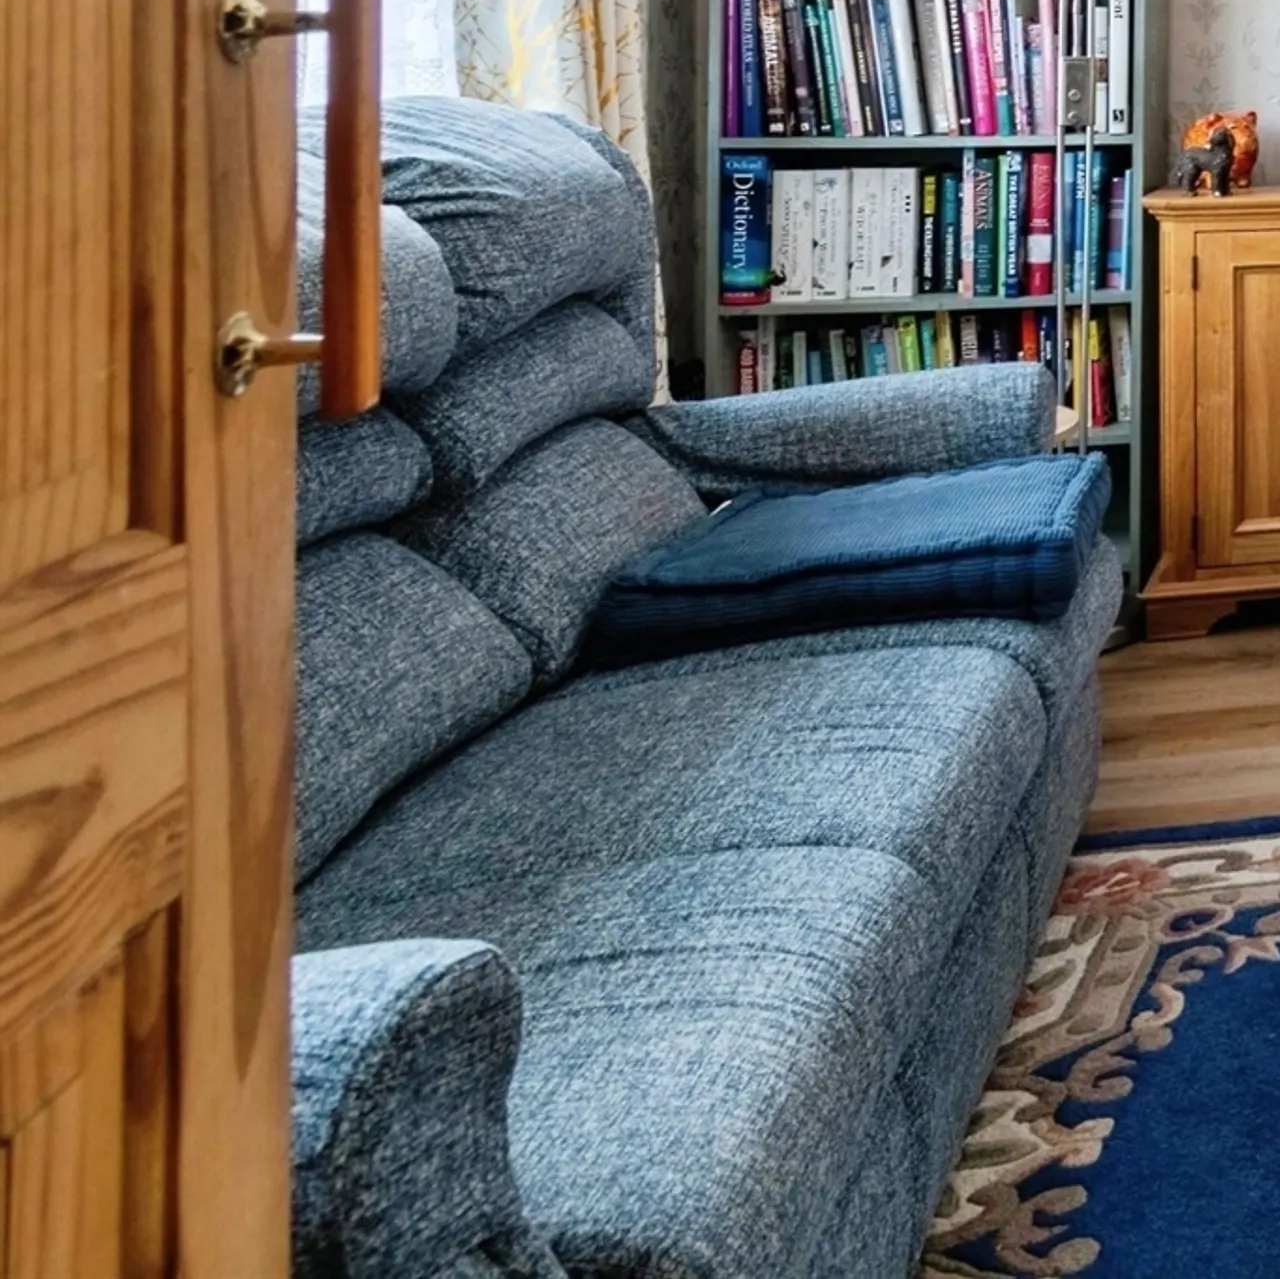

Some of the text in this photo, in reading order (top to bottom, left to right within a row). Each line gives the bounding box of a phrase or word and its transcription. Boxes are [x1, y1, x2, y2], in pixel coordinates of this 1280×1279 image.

[726, 173, 755, 271] Dictionary
[975, 168, 993, 230] ANIMALS
[1008, 175, 1018, 276] THE GREAT BRITISH YEAR
